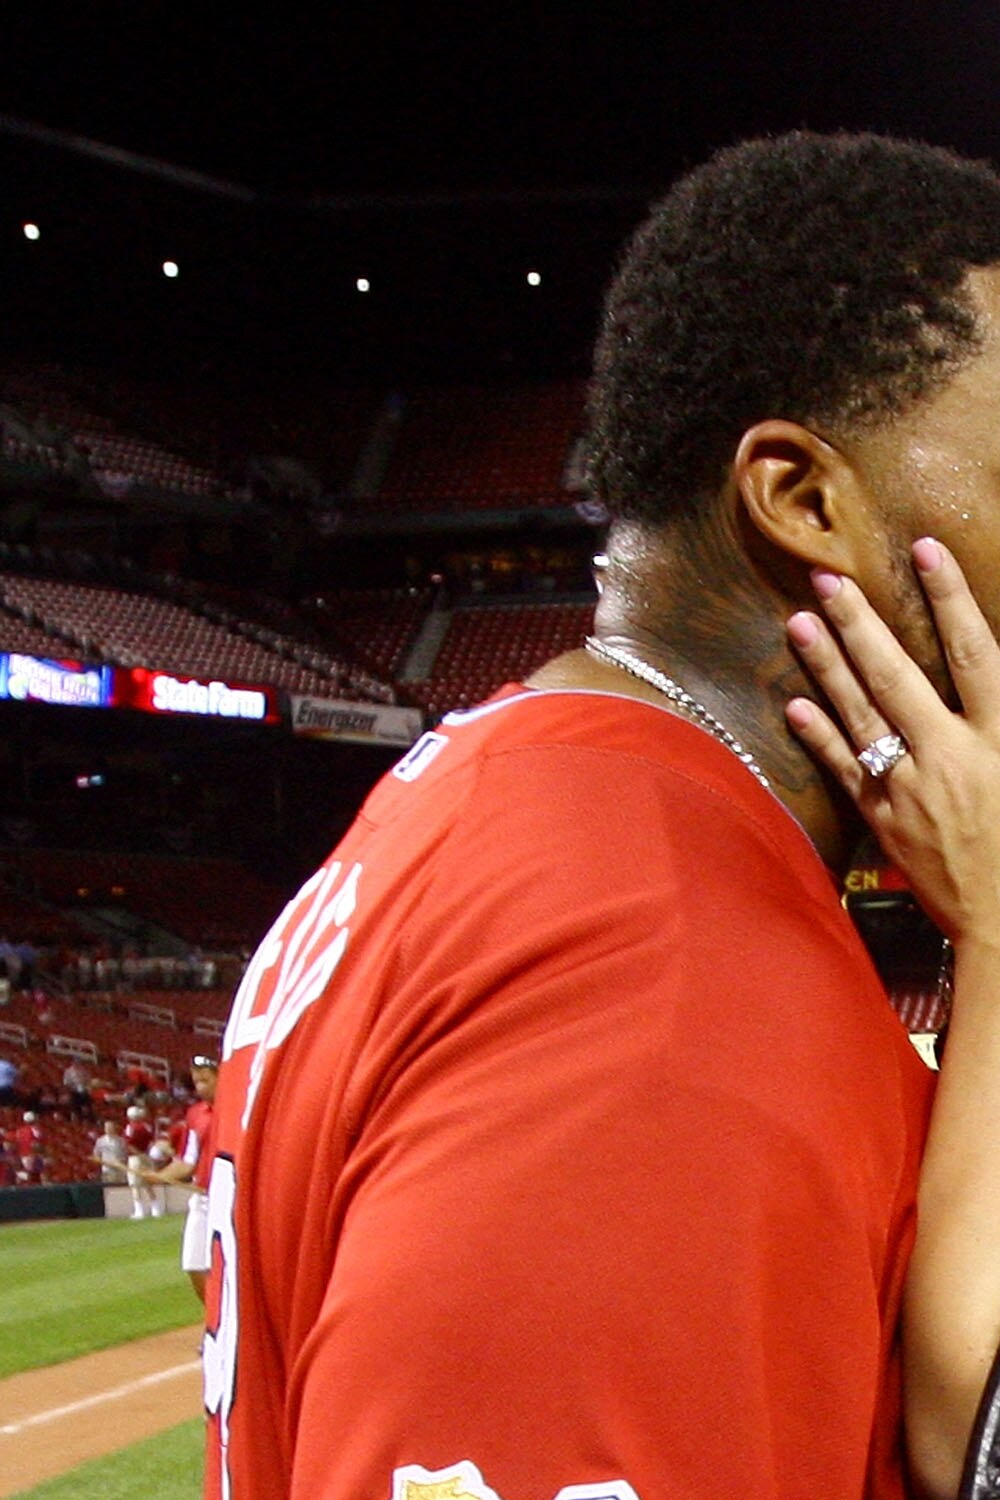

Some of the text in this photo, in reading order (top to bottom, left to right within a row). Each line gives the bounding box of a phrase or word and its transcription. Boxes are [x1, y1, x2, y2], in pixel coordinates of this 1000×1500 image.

[153, 675, 265, 719] State Farm
[296, 700, 378, 733] Energizer
